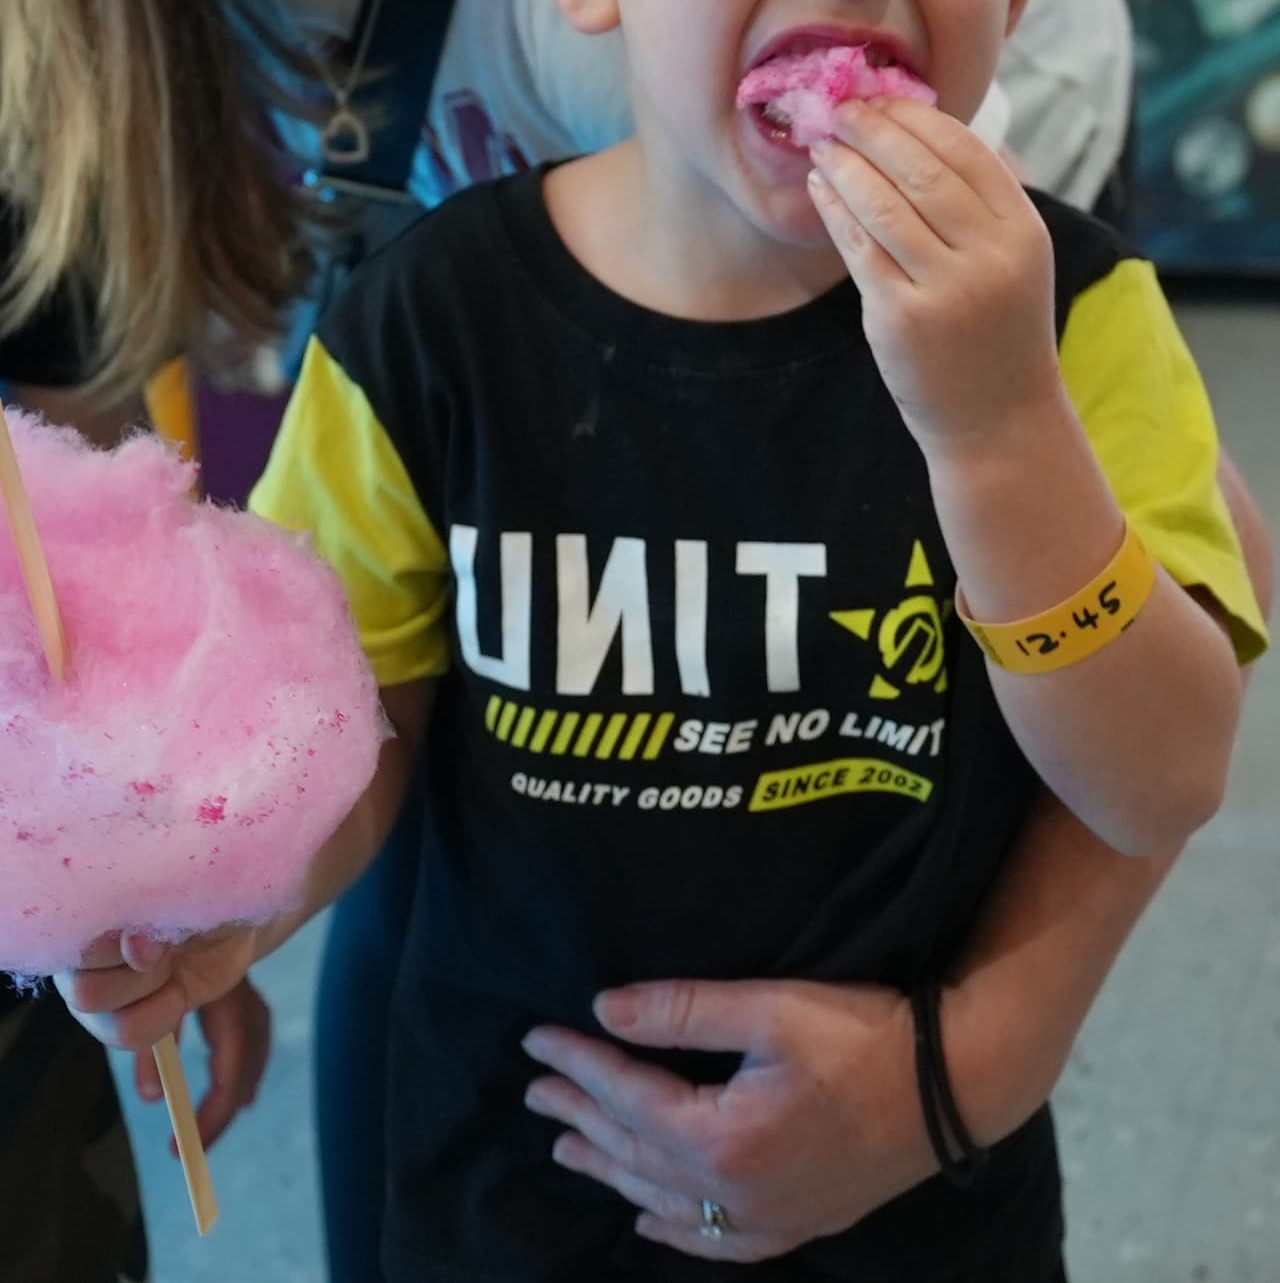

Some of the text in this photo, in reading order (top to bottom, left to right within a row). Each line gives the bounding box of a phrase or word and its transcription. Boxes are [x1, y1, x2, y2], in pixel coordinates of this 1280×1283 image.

[450, 524, 827, 698] UNIT
[1015, 580, 1120, 657] 12.45
[673, 719, 758, 755] SEE
[765, 708, 831, 746] NO
[511, 773, 628, 806] QUALITY
[637, 784, 744, 810] GOODS
[762, 767, 849, 802] SINCE
